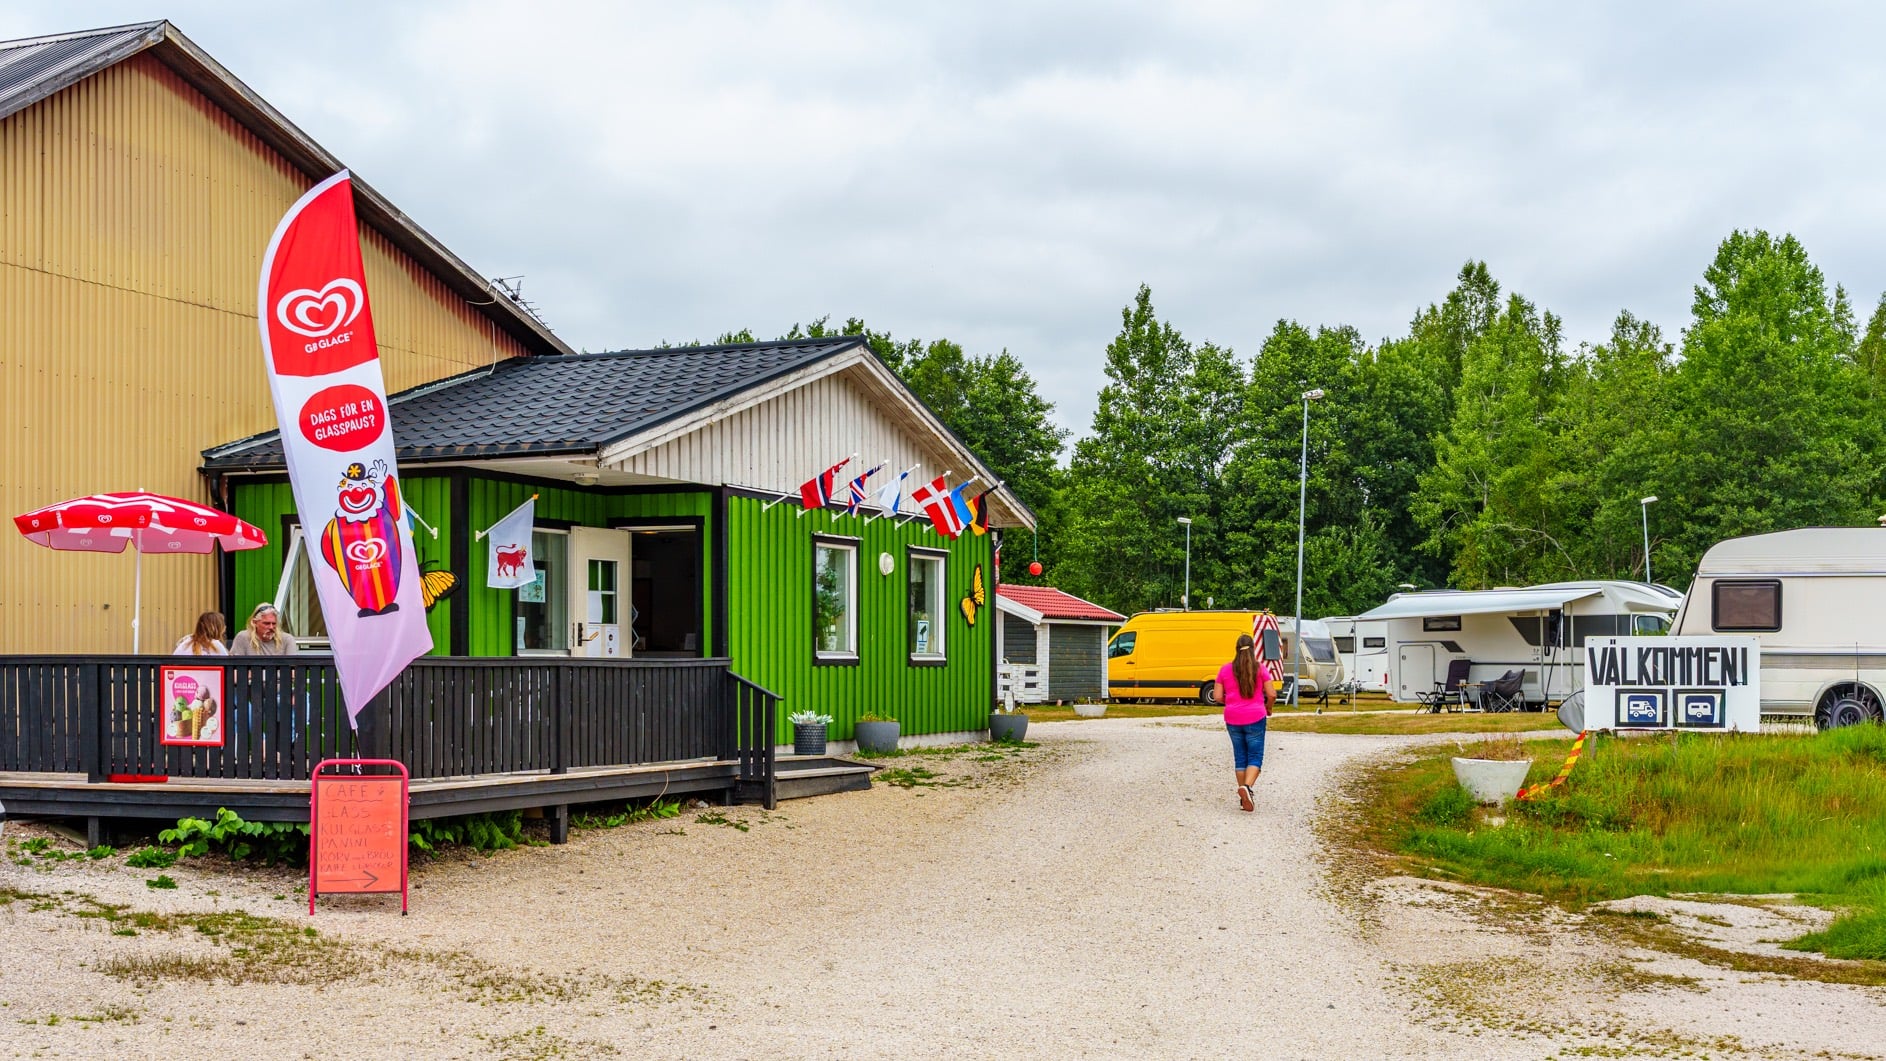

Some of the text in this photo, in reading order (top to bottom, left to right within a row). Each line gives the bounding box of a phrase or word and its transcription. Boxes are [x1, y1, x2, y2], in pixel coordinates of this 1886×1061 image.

[310, 399, 374, 426] DAGS FÖR EN
[315, 414, 376, 441] GLASSPAUS?
